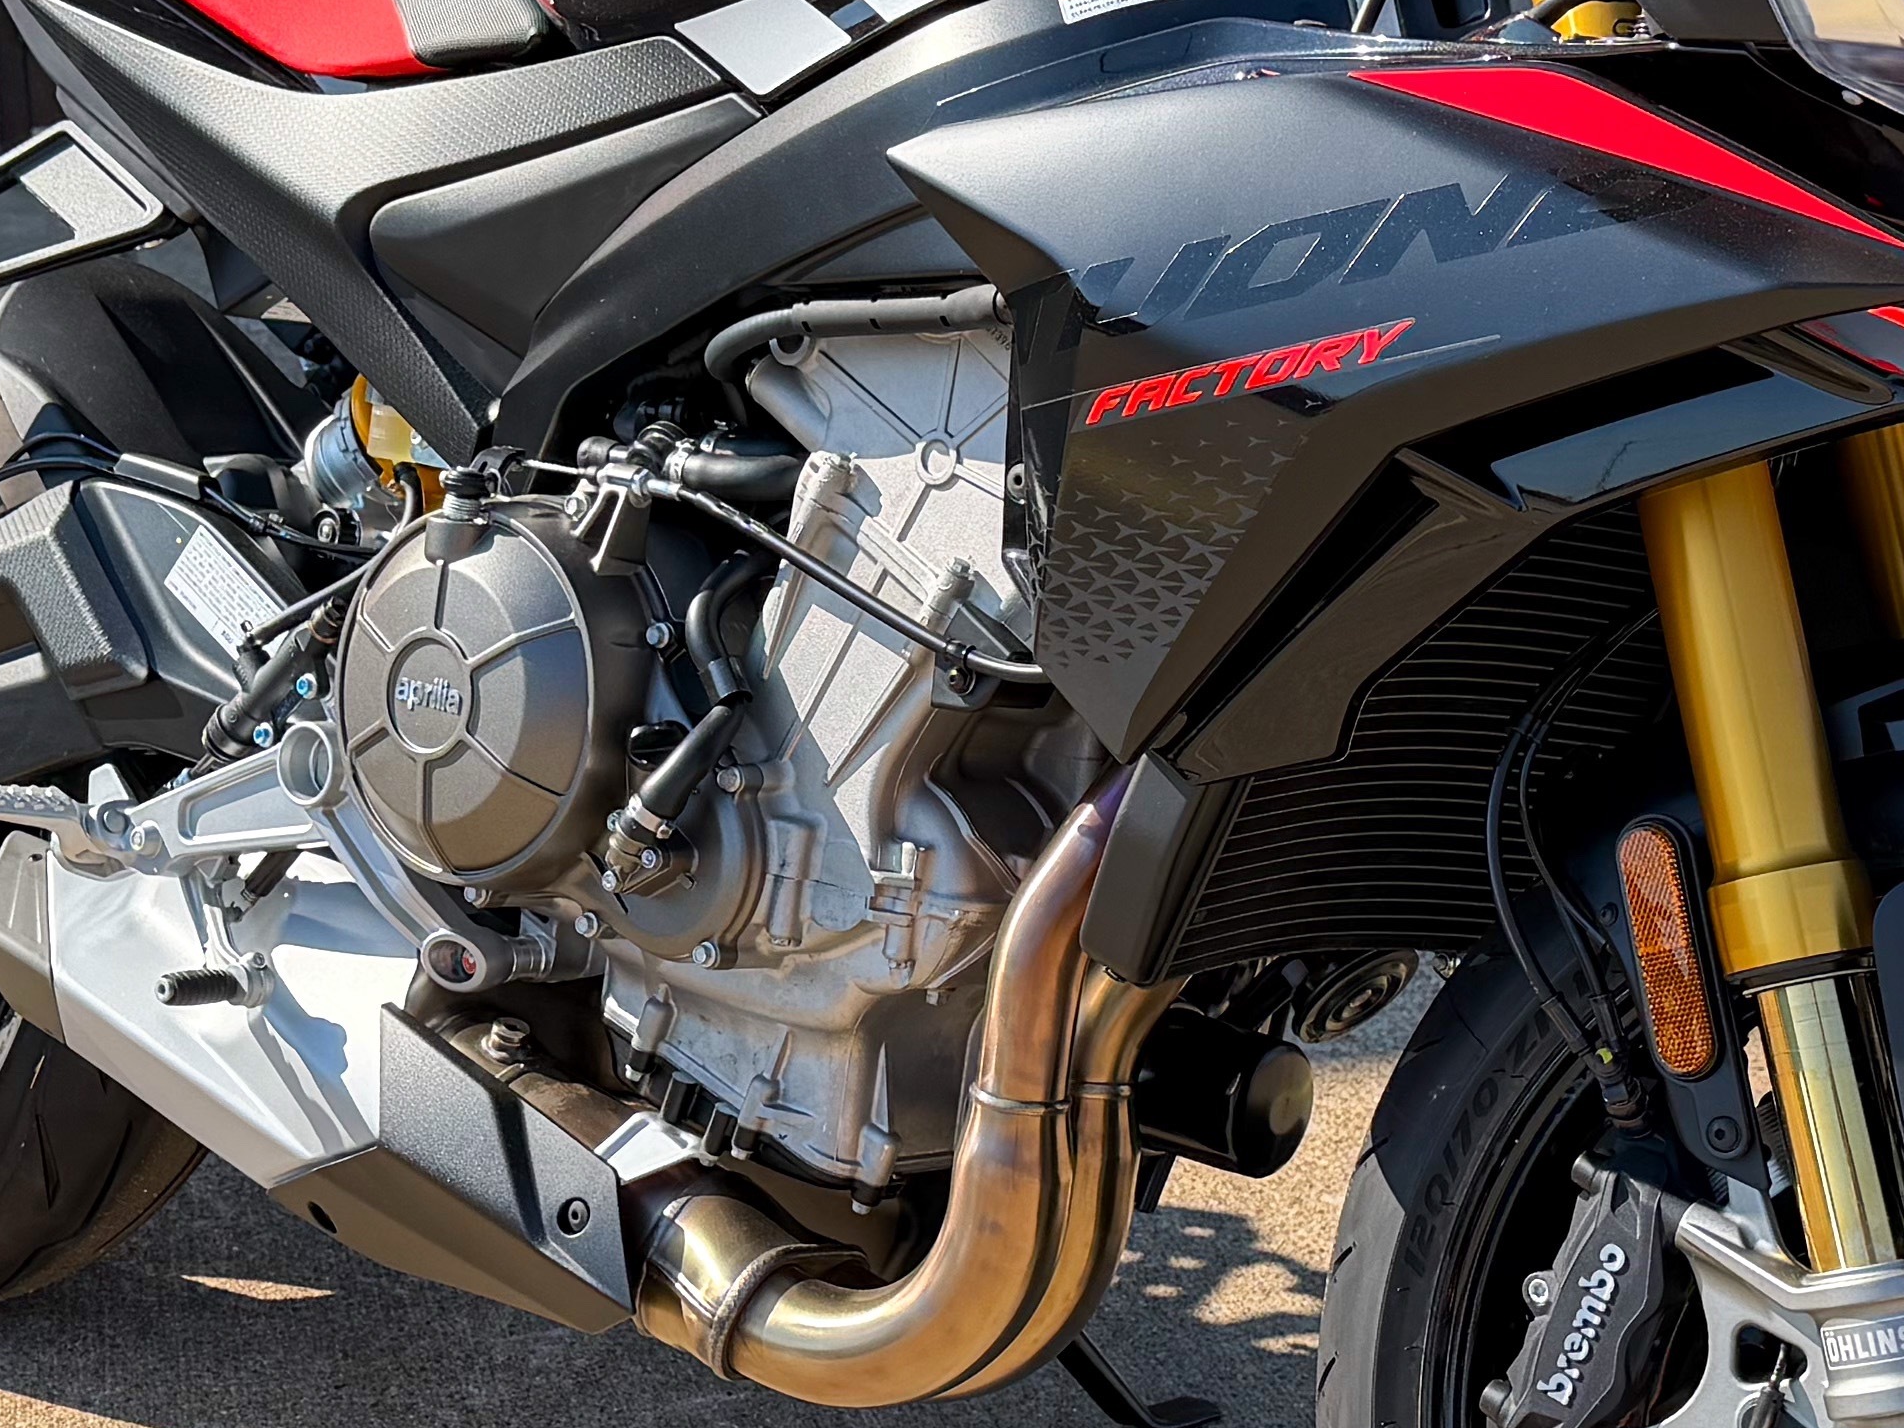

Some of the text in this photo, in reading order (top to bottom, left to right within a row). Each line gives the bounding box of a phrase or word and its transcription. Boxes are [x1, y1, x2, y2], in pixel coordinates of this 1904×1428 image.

[1086, 318, 1415, 425] FACTORY
[396, 677, 462, 716] aprilia
[1536, 1242, 1626, 1407] brembo
